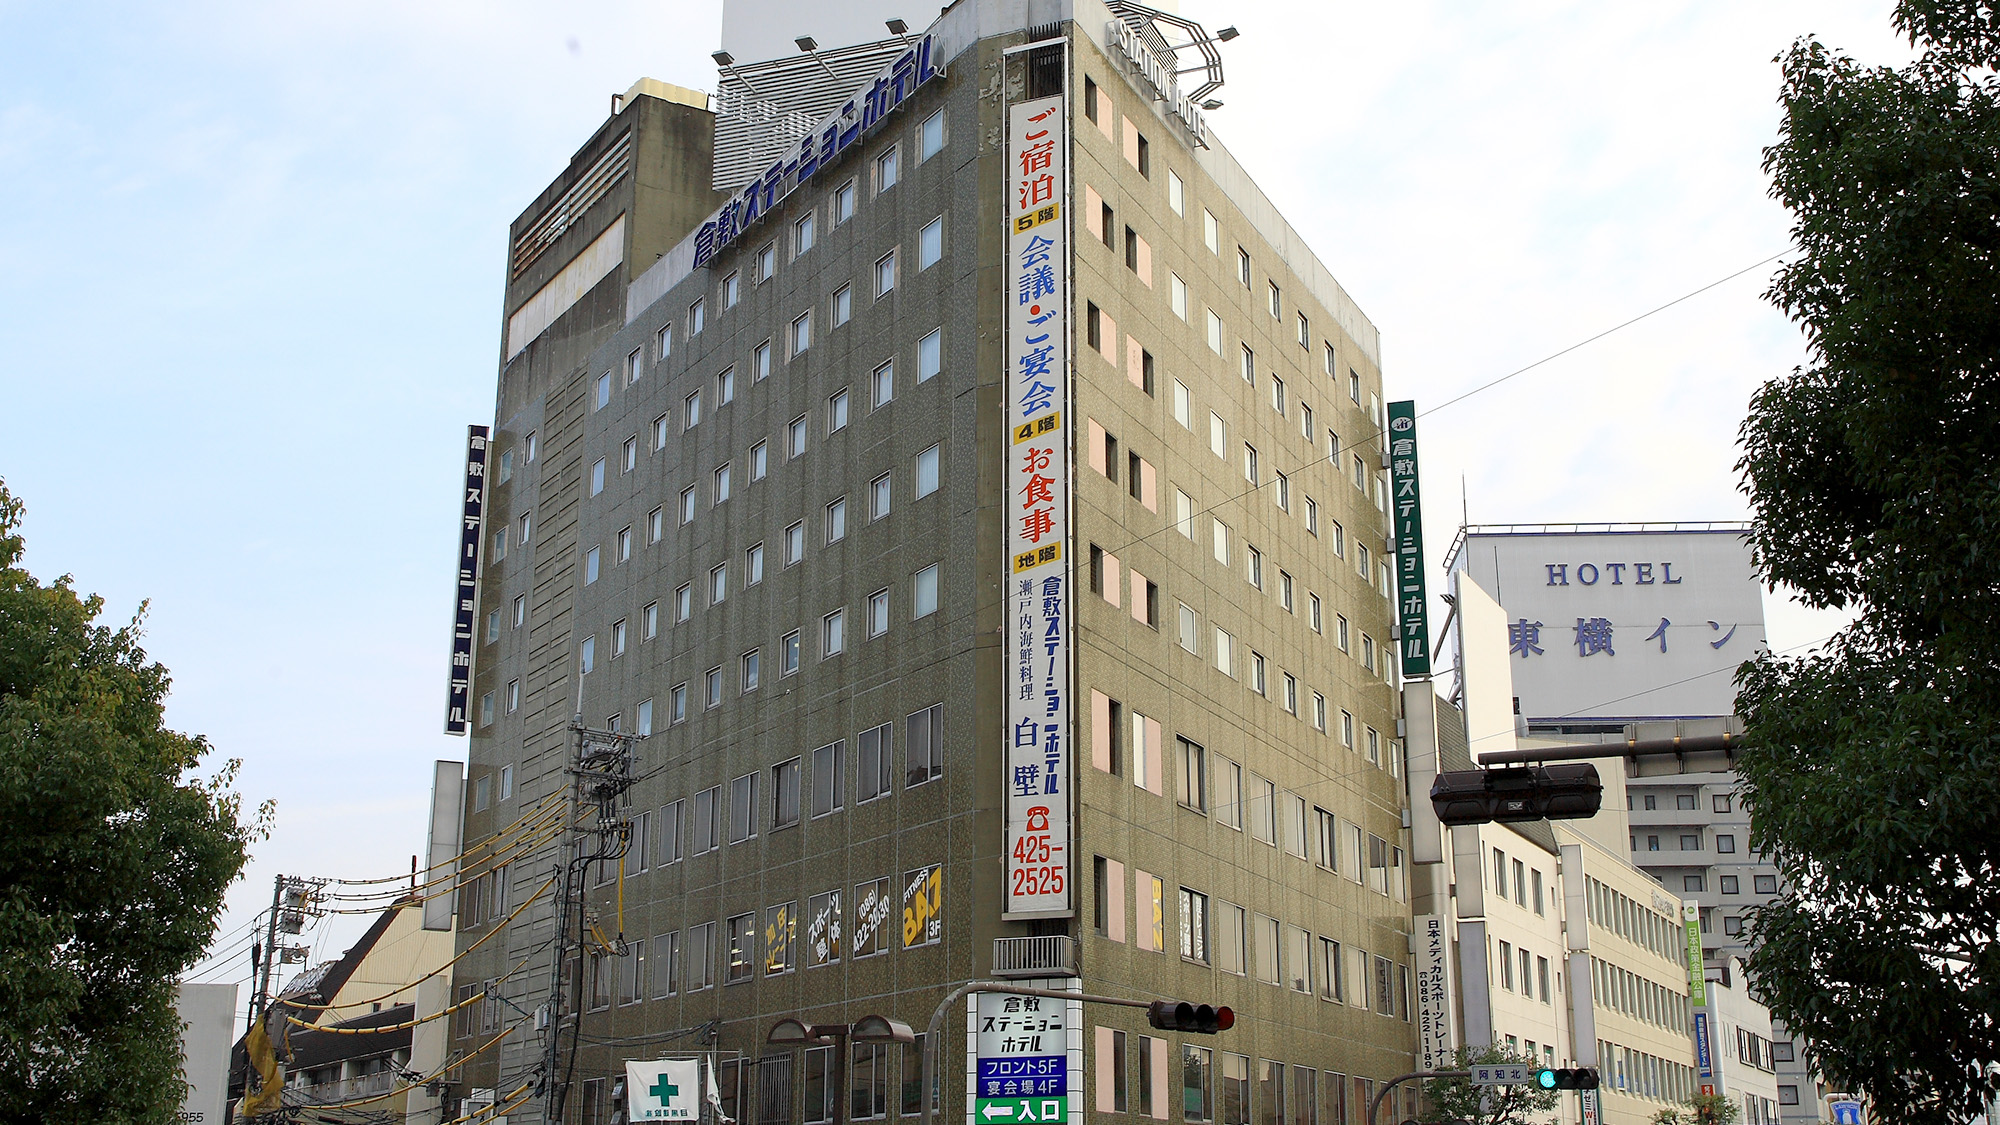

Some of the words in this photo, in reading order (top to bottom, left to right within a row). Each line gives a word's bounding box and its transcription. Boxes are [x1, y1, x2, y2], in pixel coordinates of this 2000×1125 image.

[692, 34, 937, 270] 倉敷ステーションホテル
[1018, 107, 1056, 210] ご宿泊
[1017, 206, 1055, 231] 5階
[1018, 417, 1055, 439] 4階
[1018, 447, 1056, 543] お食事
[1018, 546, 1056, 569] 地階
[1392, 438, 1424, 659] 倉敷ステーションホテル
[449, 434, 487, 723] 倉敷ステーションホテル
[1545, 562, 1682, 586] HOTEL
[1507, 616, 1738, 658] 東横イン
[1042, 576, 1062, 795] 倉敷ステーションホテル
[1013, 866, 1064, 896] 2525
[929, 919, 941, 937] 3F
[1003, 996, 1041, 1013] 倉敷
[982, 1014, 1062, 1033] ステーション
[1001, 1035, 1042, 1053] ホテル
[986, 1059, 1058, 1075] フロント5F
[1479, 1068, 1521, 1080] 阿知北
[177, 1112, 204, 1123] 955
[1017, 1100, 1060, 1122] 入口
